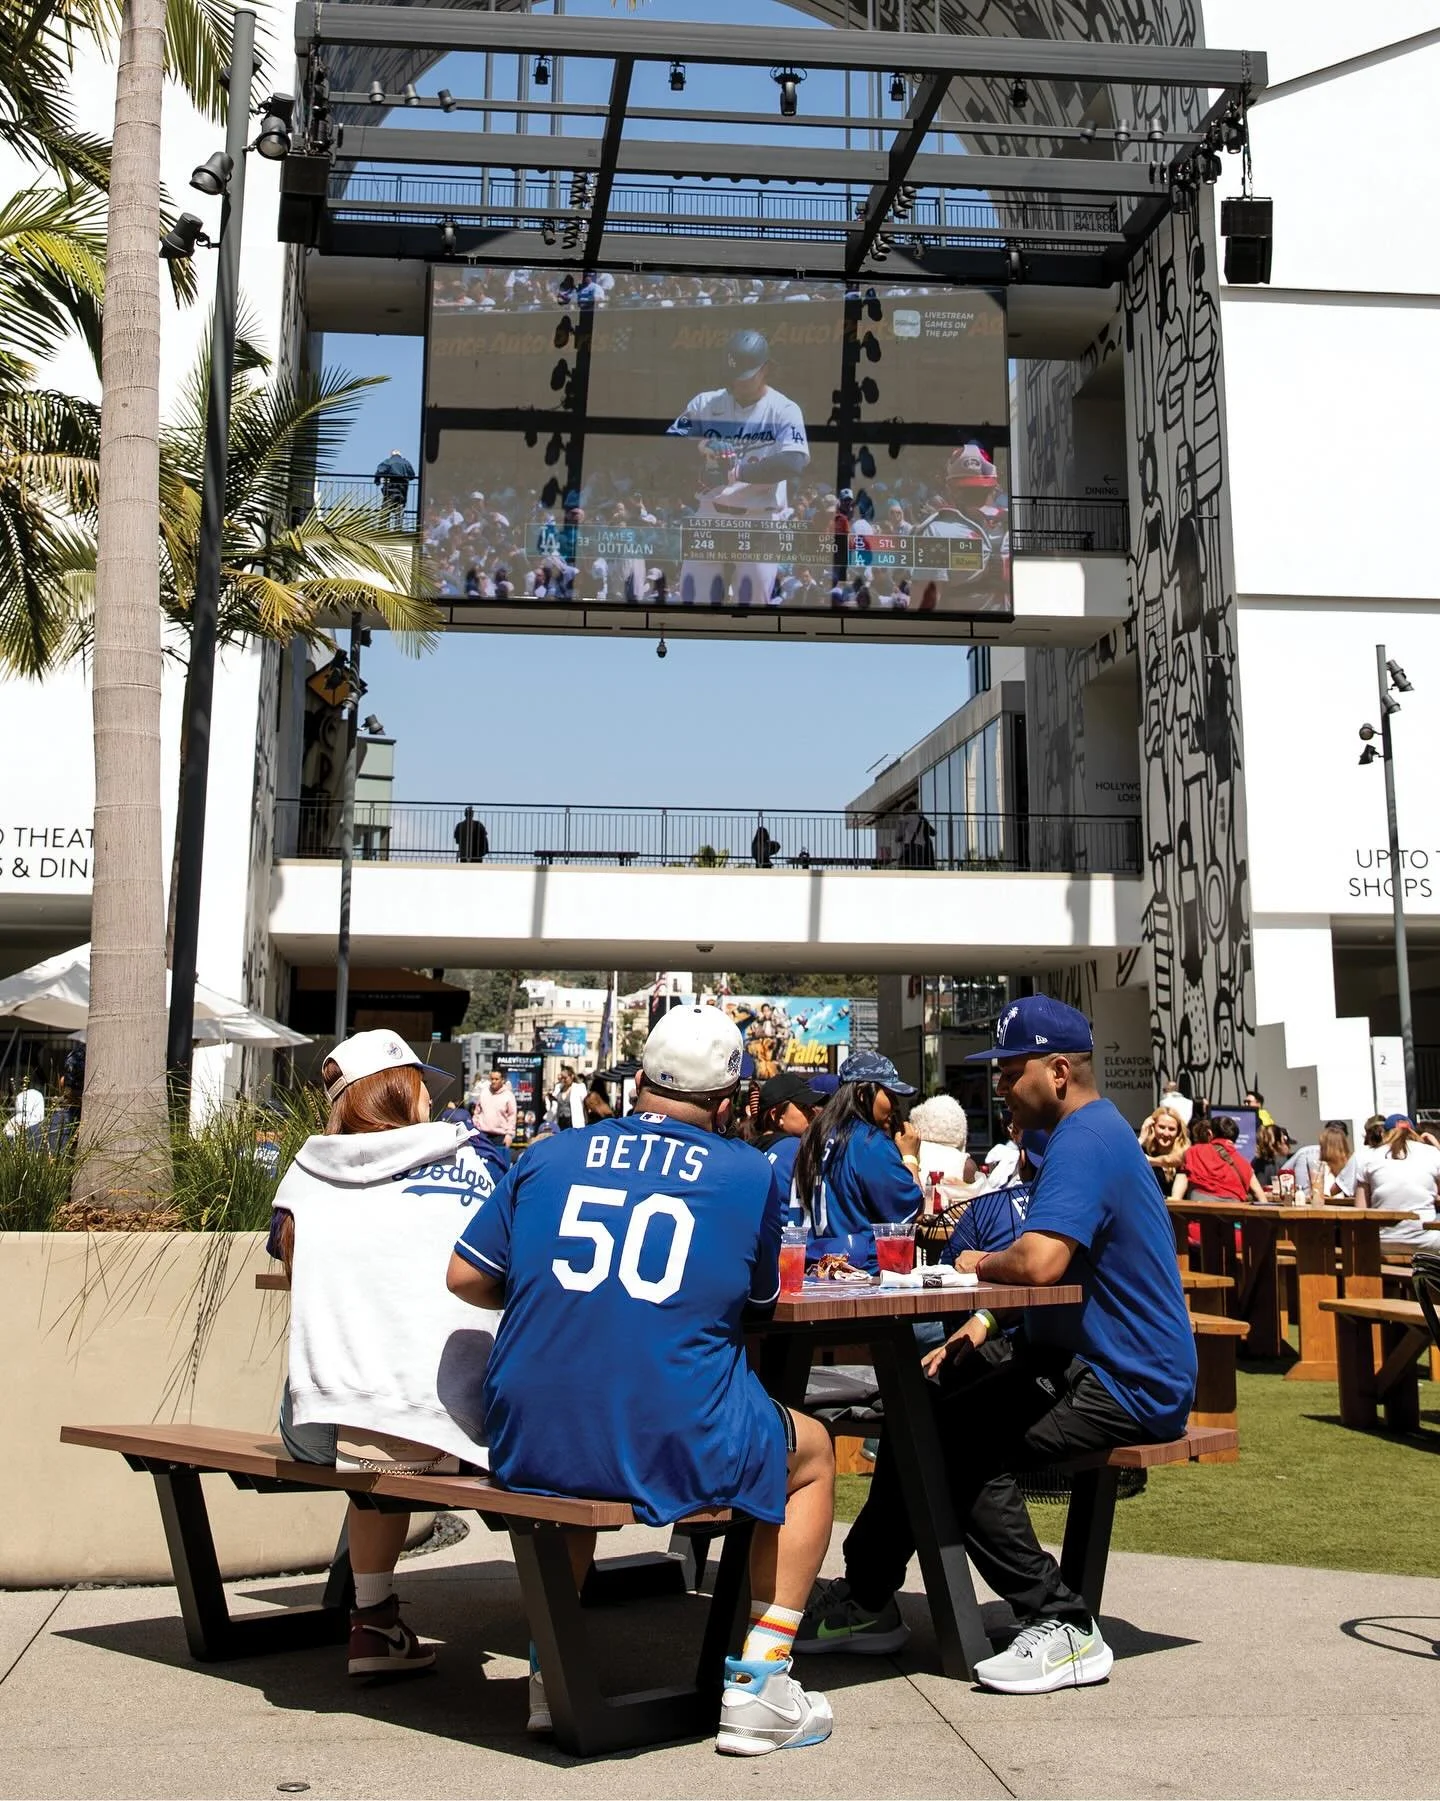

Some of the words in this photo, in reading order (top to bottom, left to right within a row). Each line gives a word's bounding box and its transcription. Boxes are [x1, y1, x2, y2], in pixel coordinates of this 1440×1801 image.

[924, 311, 974, 320] LIVESTREAM
[925, 321, 953, 329] GAMES
[954, 321, 967, 329] ON
[431, 335, 487, 357] ance
[791, 425, 804, 444] LA
[1084, 486, 1119, 495] DINING
[689, 519, 712, 528] LAST
[714, 519, 752, 529] SEASON
[775, 521, 809, 530] GAMES
[577, 536, 590, 546] 33
[598, 531, 634, 542] JAMES
[693, 531, 712, 539] AVG
[737, 532, 751, 540] HR
[779, 533, 795, 541] RBI
[818, 534, 836, 543] OPS
[597, 543, 654, 555] OUTMAN
[690, 540, 715, 550] .248
[738, 541, 751, 550] 23
[779, 542, 793, 552] 70
[816, 543, 838, 553] .790
[879, 540, 895, 549] STL
[900, 539, 907, 549] 0
[959, 541, 973, 550] 0-1
[763, 554, 774, 562] OF
[878, 554, 895, 564] LAD
[900, 555, 907, 565] 2
[1095, 782, 1141, 790] HOLLYWO
[1118, 794, 1141, 802] LOEW
[13, 827, 95, 848] THEAT
[1356, 849, 1391, 868] UP
[1398, 850, 1428, 868] TO
[12, 857, 30, 878] &
[40, 857, 95, 878] DIN
[1104, 1056, 1153, 1065] ELEVATOR
[1380, 1055, 1387, 1065] 2
[1105, 1069, 1136, 1077] LUCKY
[1105, 1080, 1153, 1089] HIGHLAN
[585, 1133, 709, 1182] BETTS
[391, 1157, 494, 1206] Dodger
[551, 1184, 696, 1305] 50
